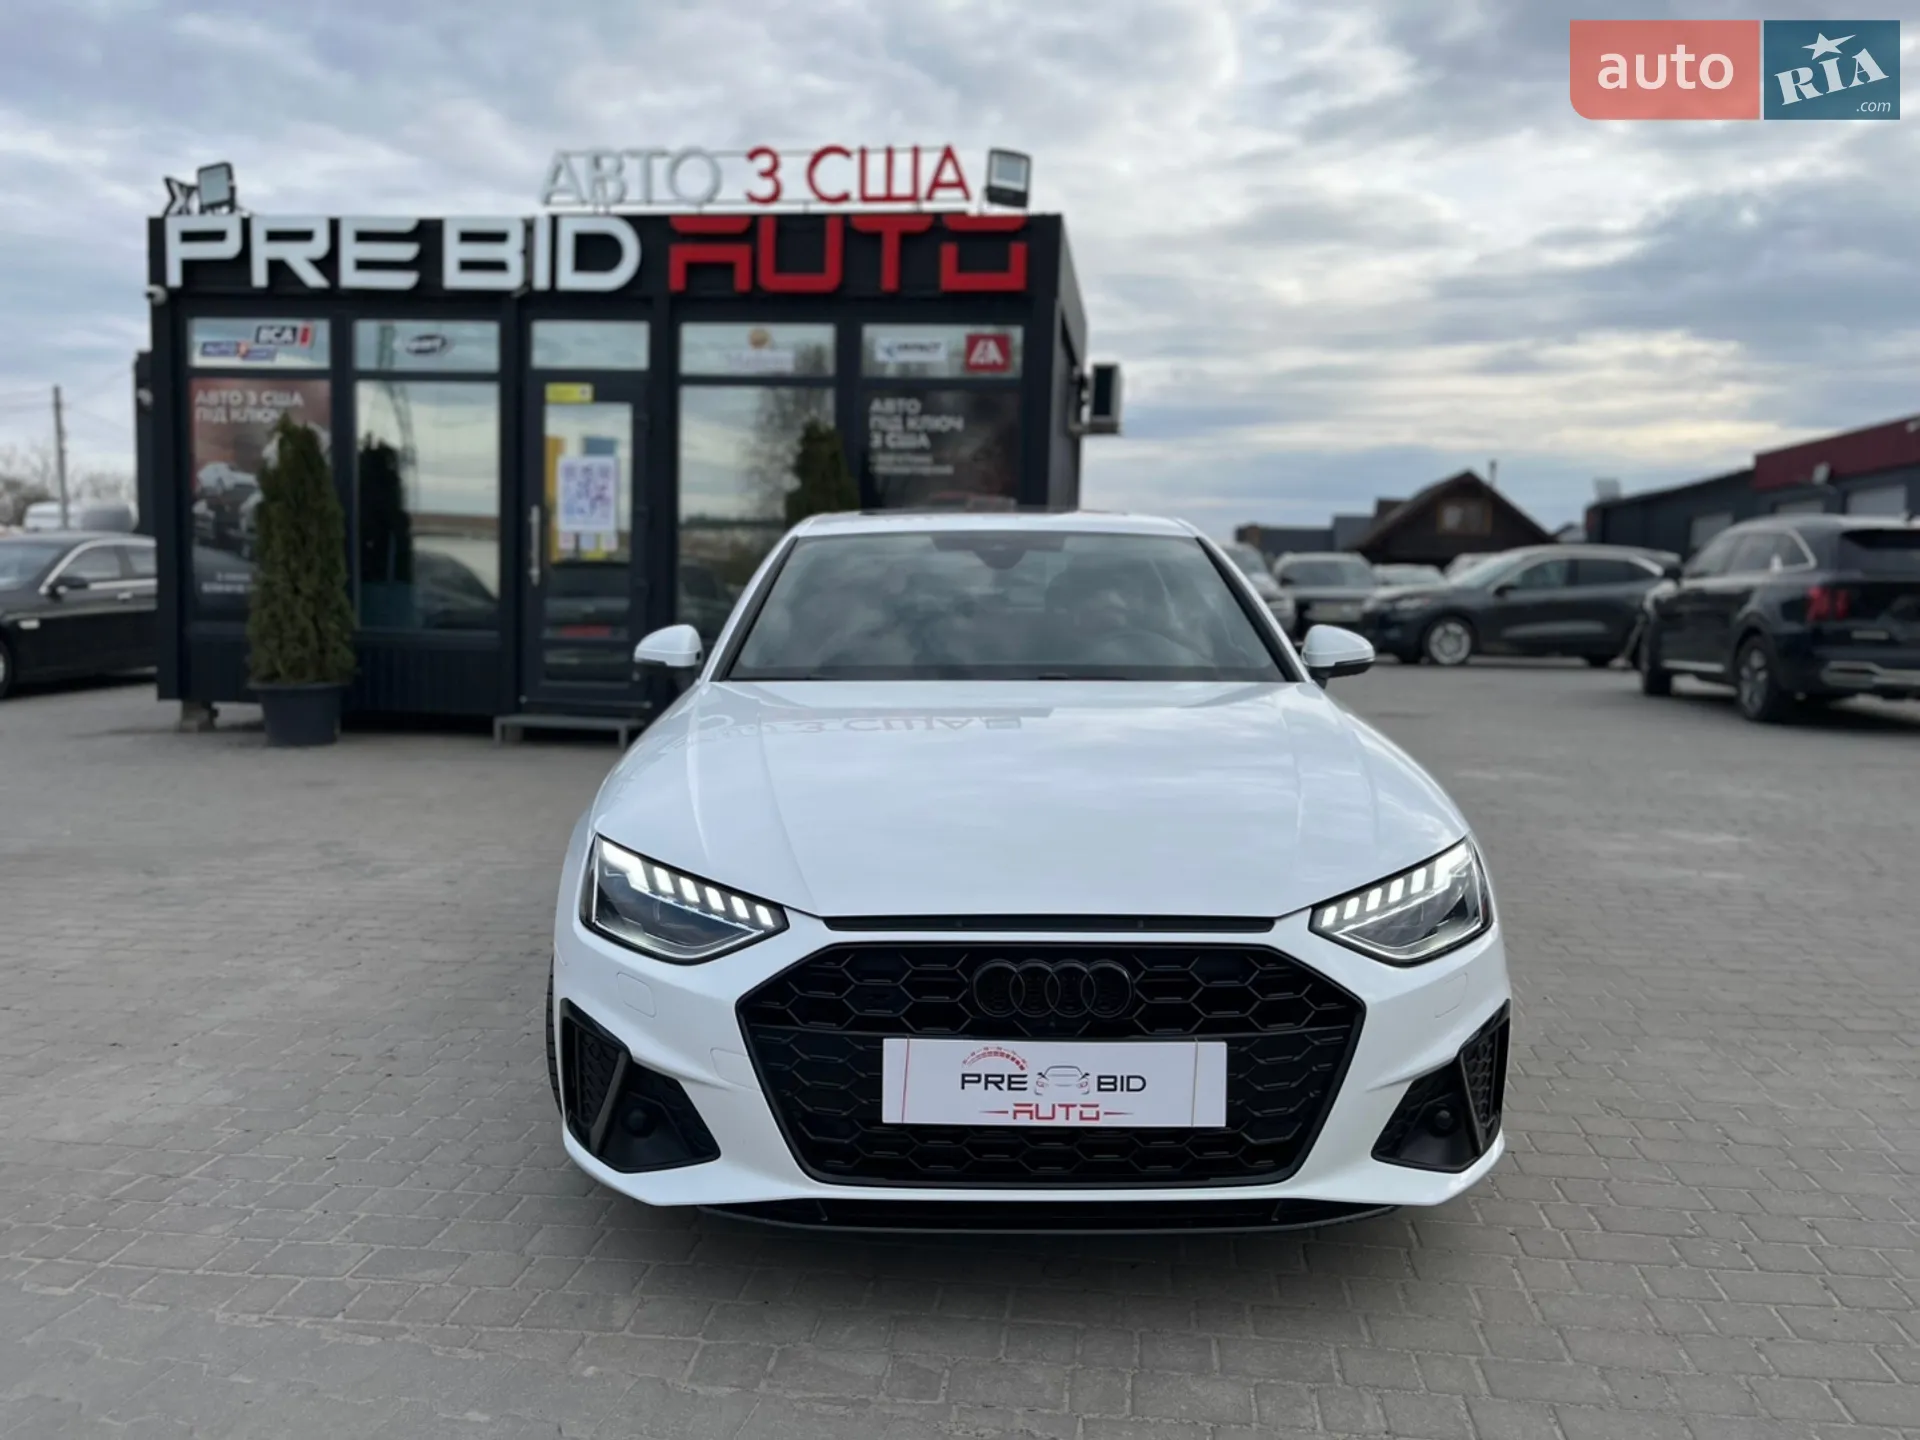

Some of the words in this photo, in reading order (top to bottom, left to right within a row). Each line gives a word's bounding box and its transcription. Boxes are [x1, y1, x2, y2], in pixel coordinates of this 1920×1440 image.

[541, 145, 722, 206] АВТО
[806, 145, 971, 203] США
[164, 216, 421, 289] PRE
[443, 216, 641, 292] BID
[668, 215, 1028, 293] AUTO
[961, 1073, 1028, 1091] PRE
[1097, 1075, 1147, 1093] BID
[1012, 1103, 1100, 1121] AUTO
